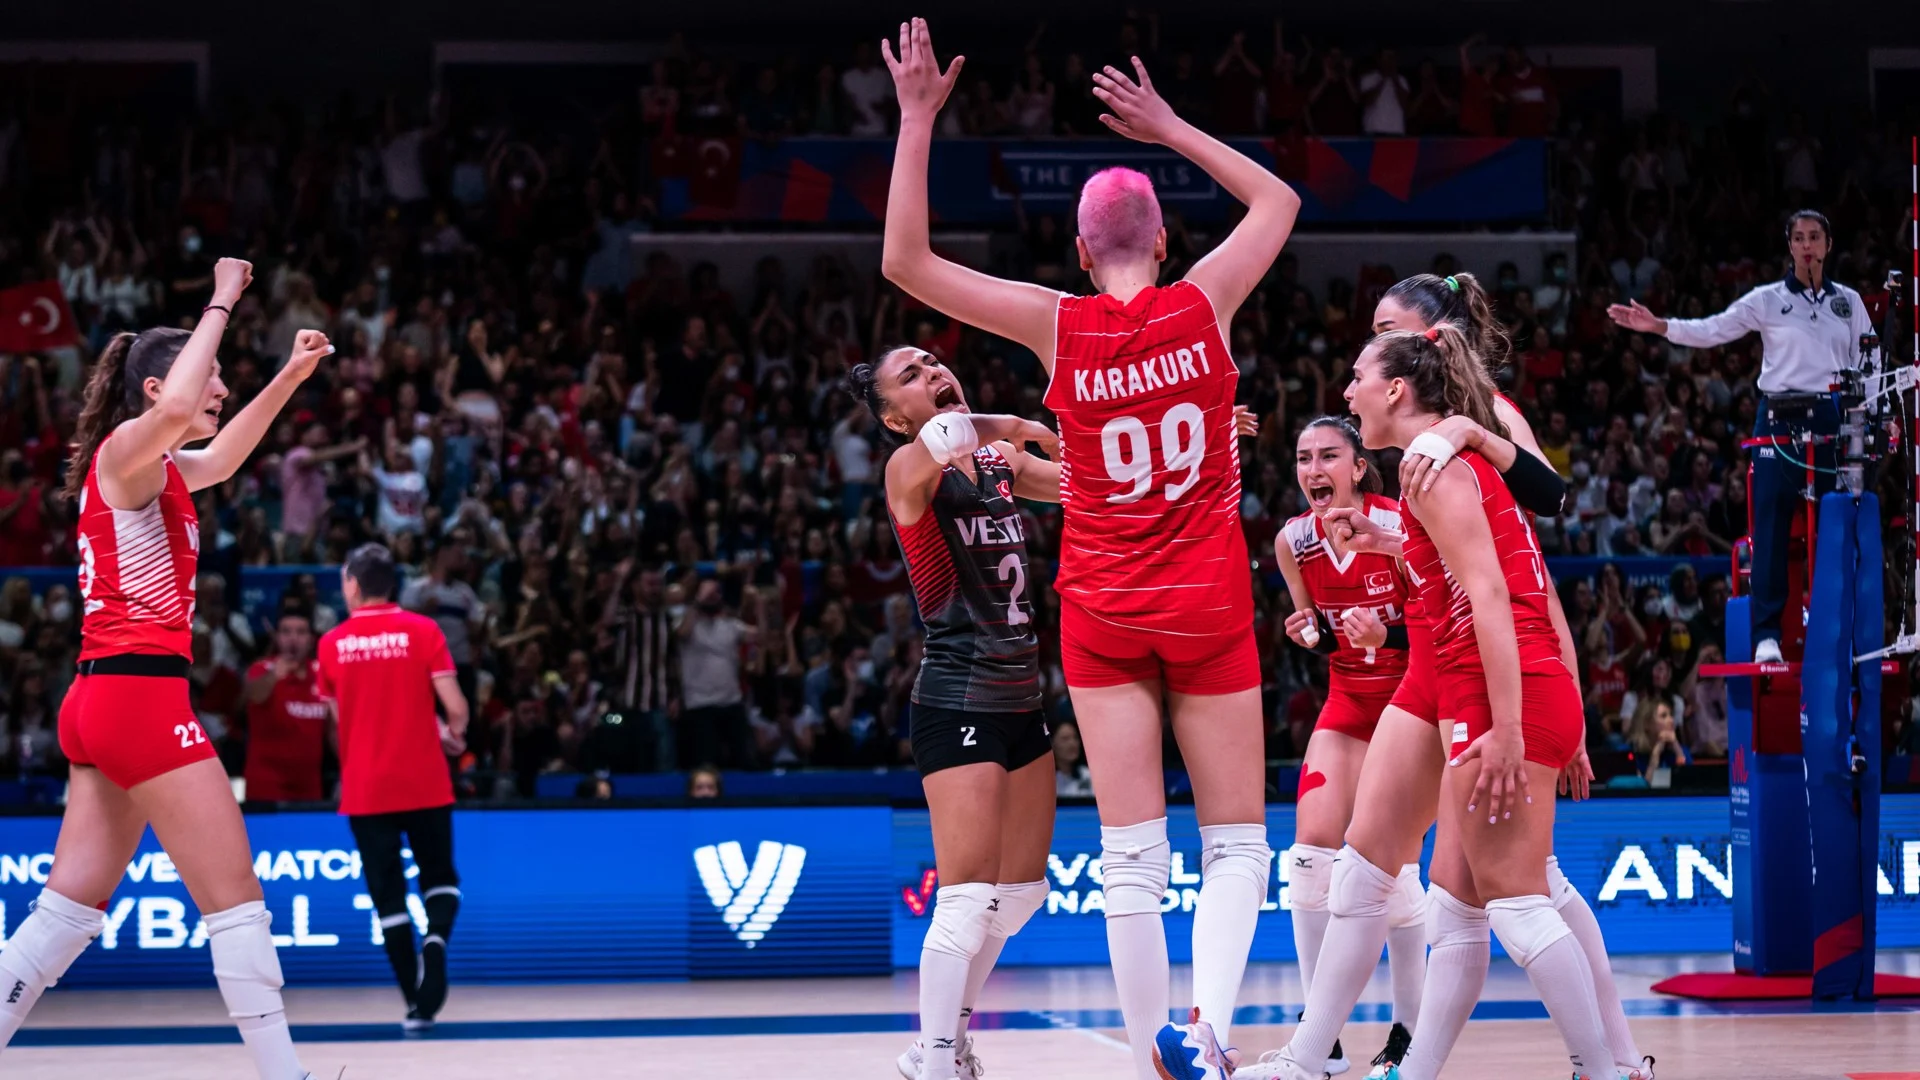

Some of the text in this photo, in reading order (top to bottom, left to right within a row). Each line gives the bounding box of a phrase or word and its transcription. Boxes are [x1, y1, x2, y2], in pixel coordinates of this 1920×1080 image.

[1019, 165, 1072, 186] THE
[1074, 341, 1211, 402] KARAKURT
[1101, 402, 1207, 504] 99
[997, 553, 1030, 626] 2
[173, 720, 206, 748] 22
[960, 726, 977, 746] 2
